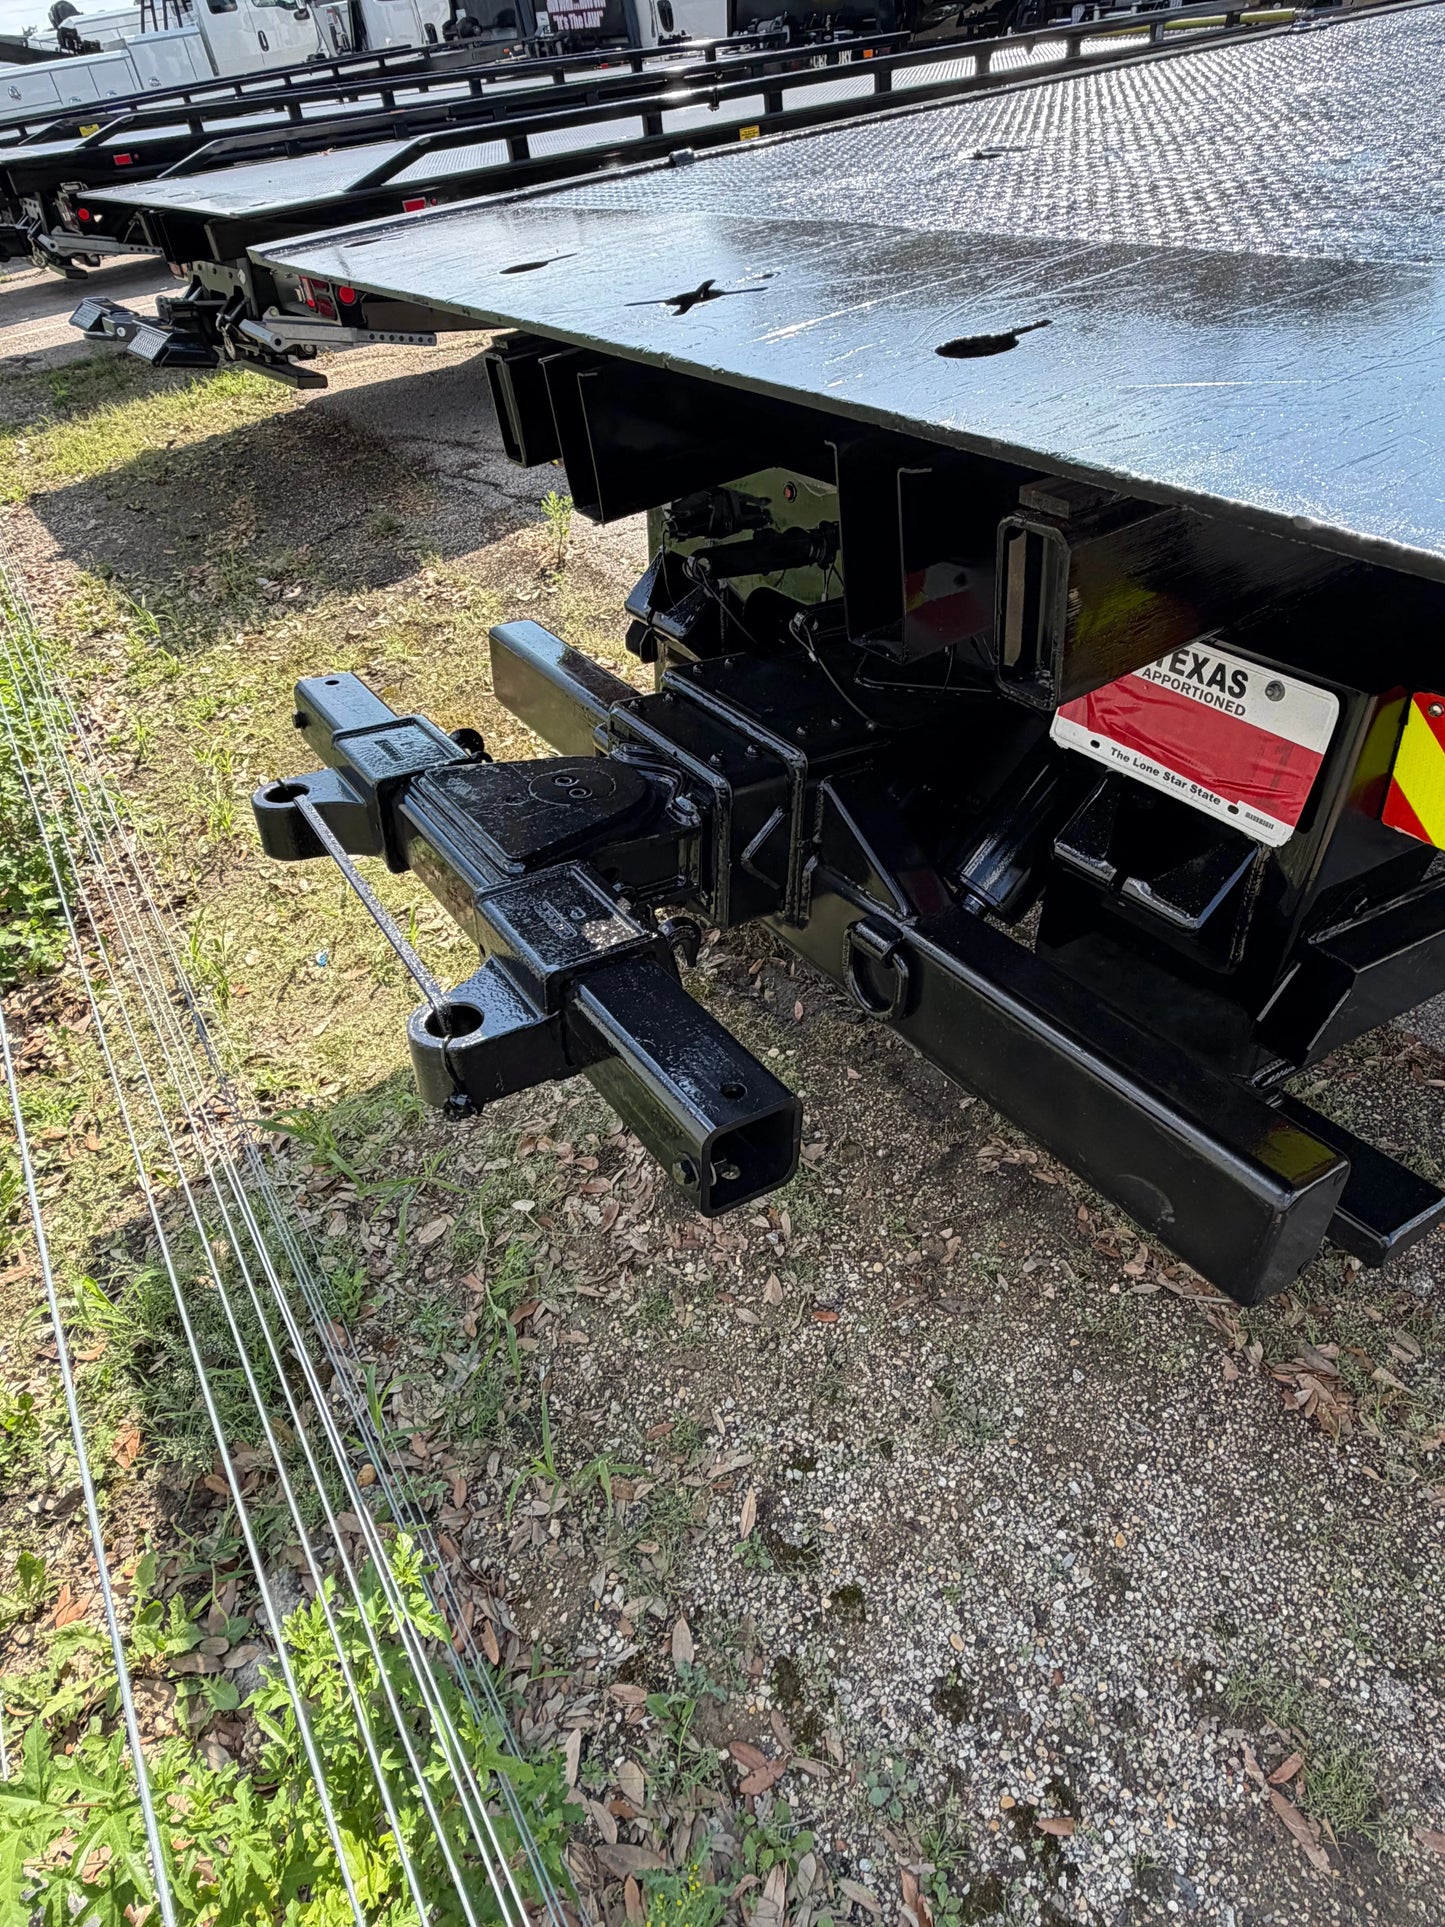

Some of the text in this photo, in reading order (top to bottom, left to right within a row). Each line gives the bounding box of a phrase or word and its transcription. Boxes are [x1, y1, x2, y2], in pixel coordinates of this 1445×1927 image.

[1141, 666, 1247, 717] APPORTIONED
[1109, 746, 1222, 806] The Lone Star State
